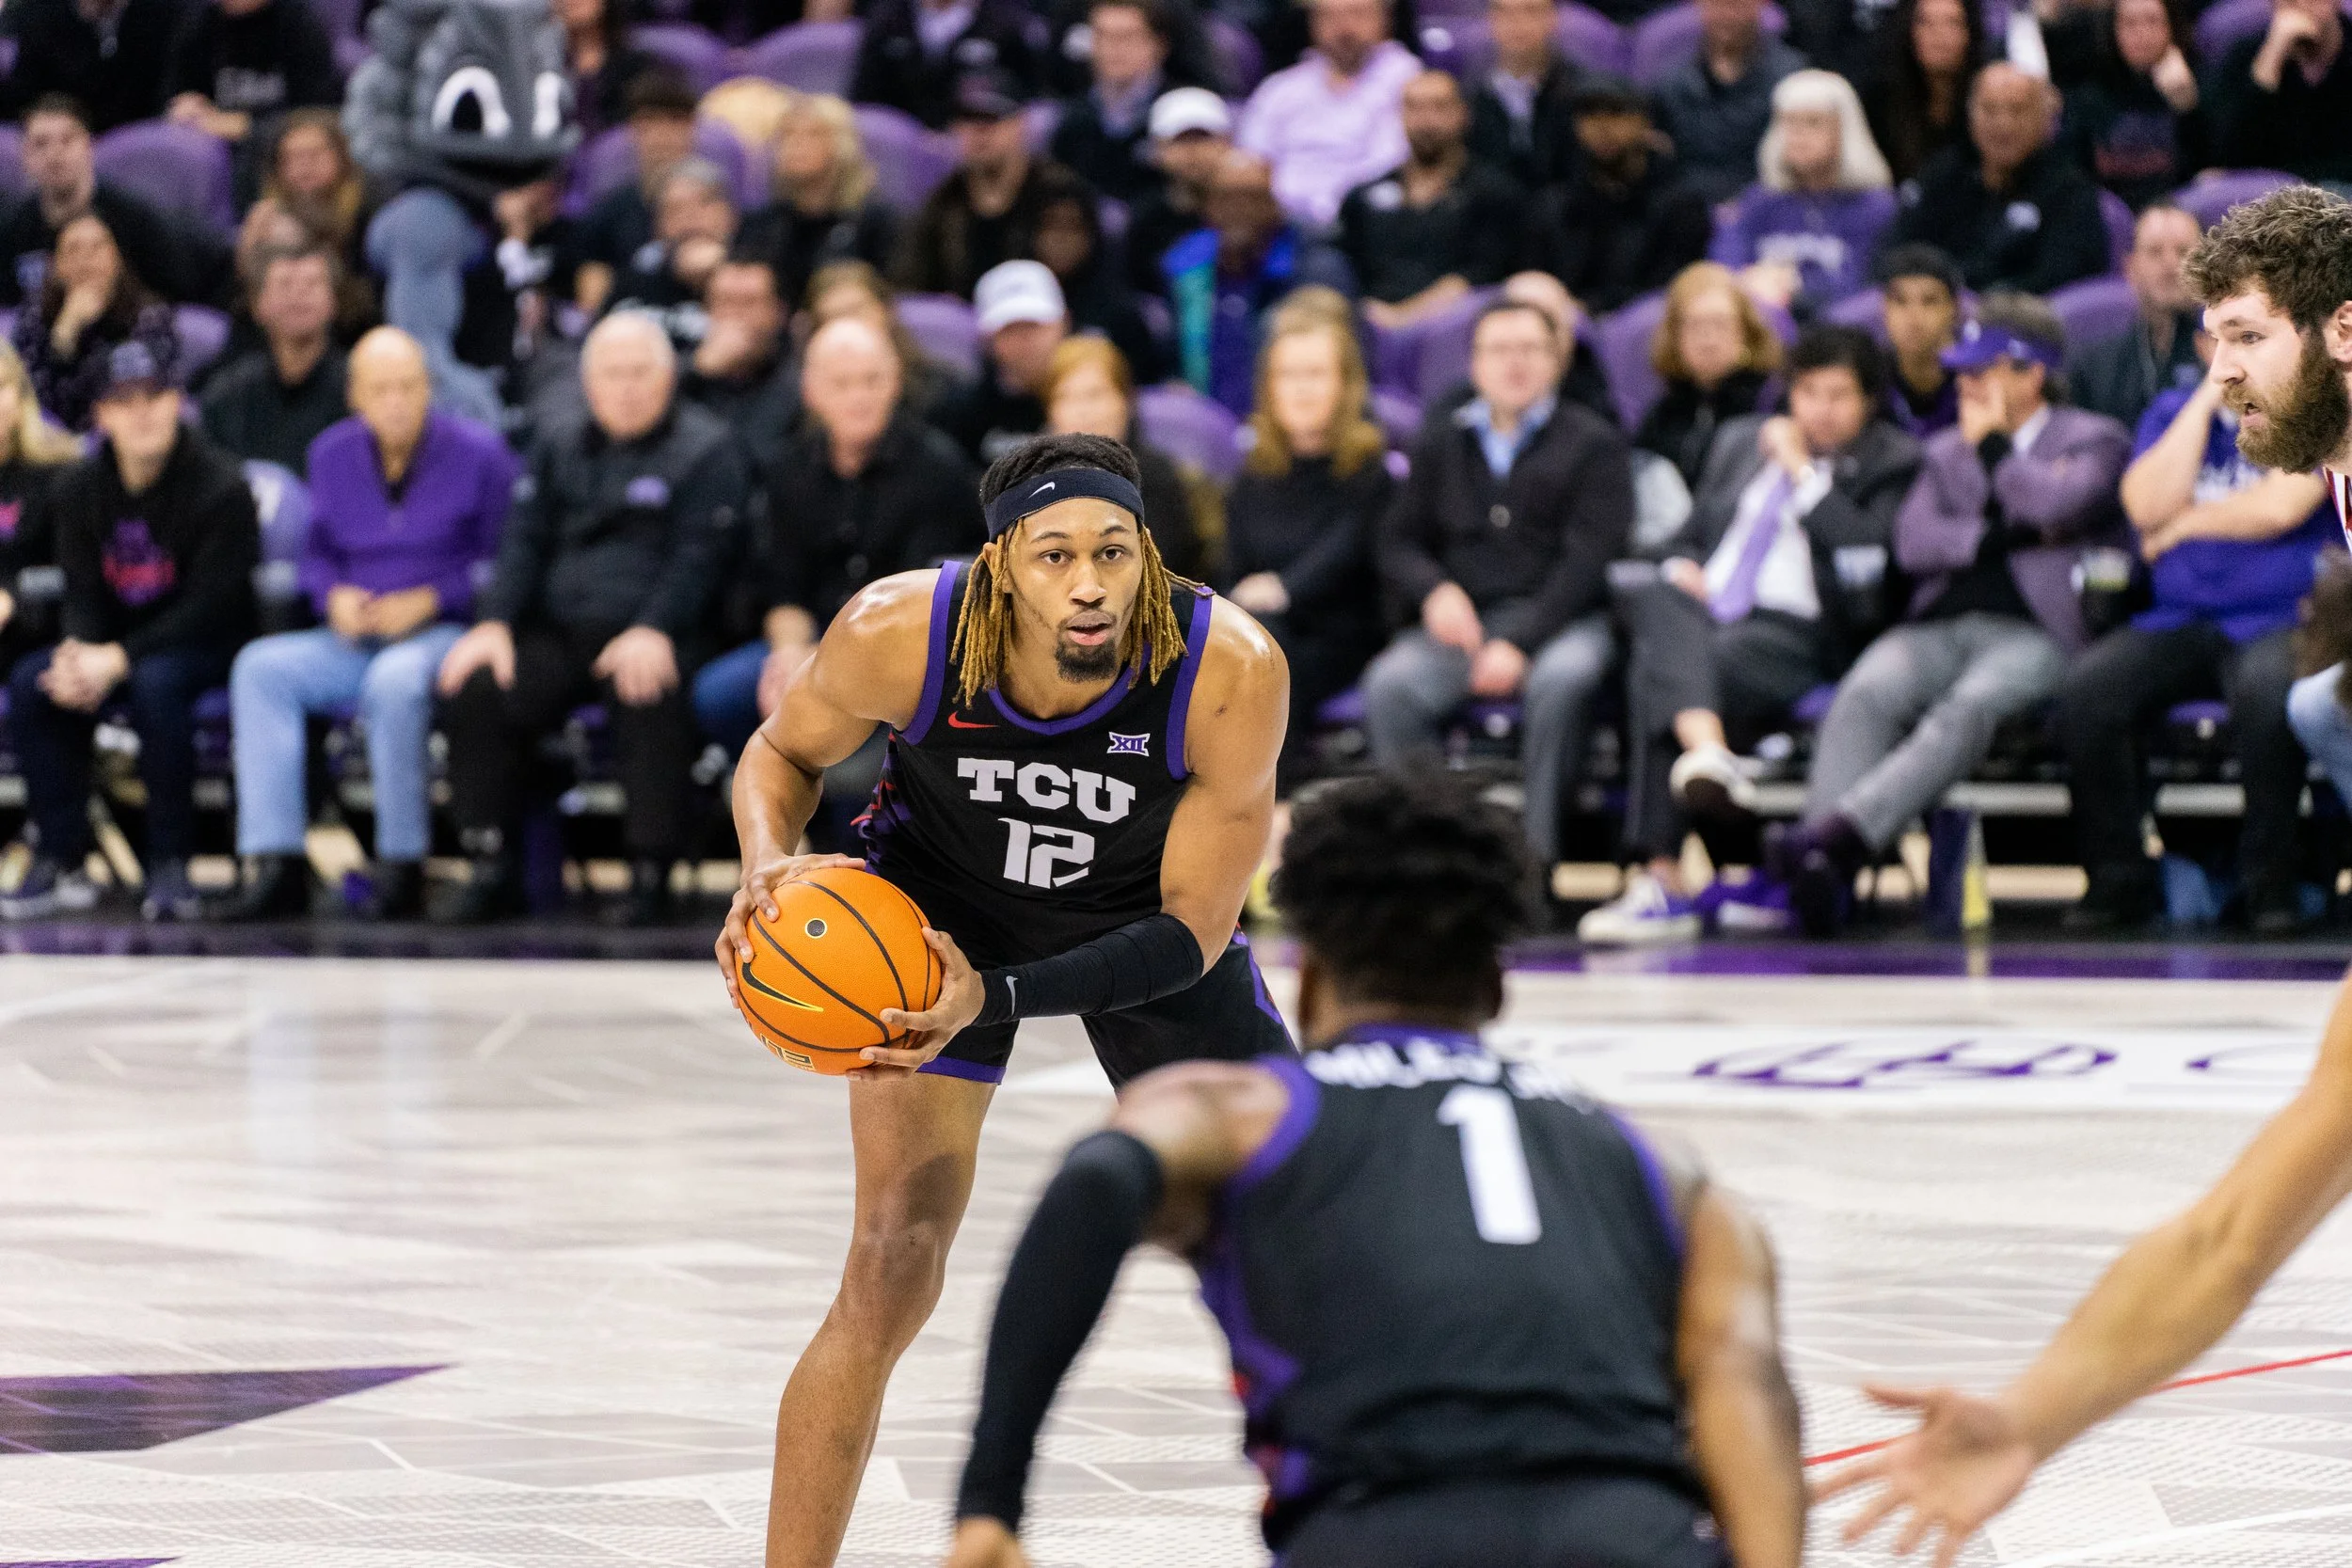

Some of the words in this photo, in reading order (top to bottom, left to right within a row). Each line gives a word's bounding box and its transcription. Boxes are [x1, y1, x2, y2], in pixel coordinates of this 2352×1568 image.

[957, 757, 1136, 824] TCU
[997, 816, 1095, 889] 12
[1438, 1084, 1542, 1244] 1
